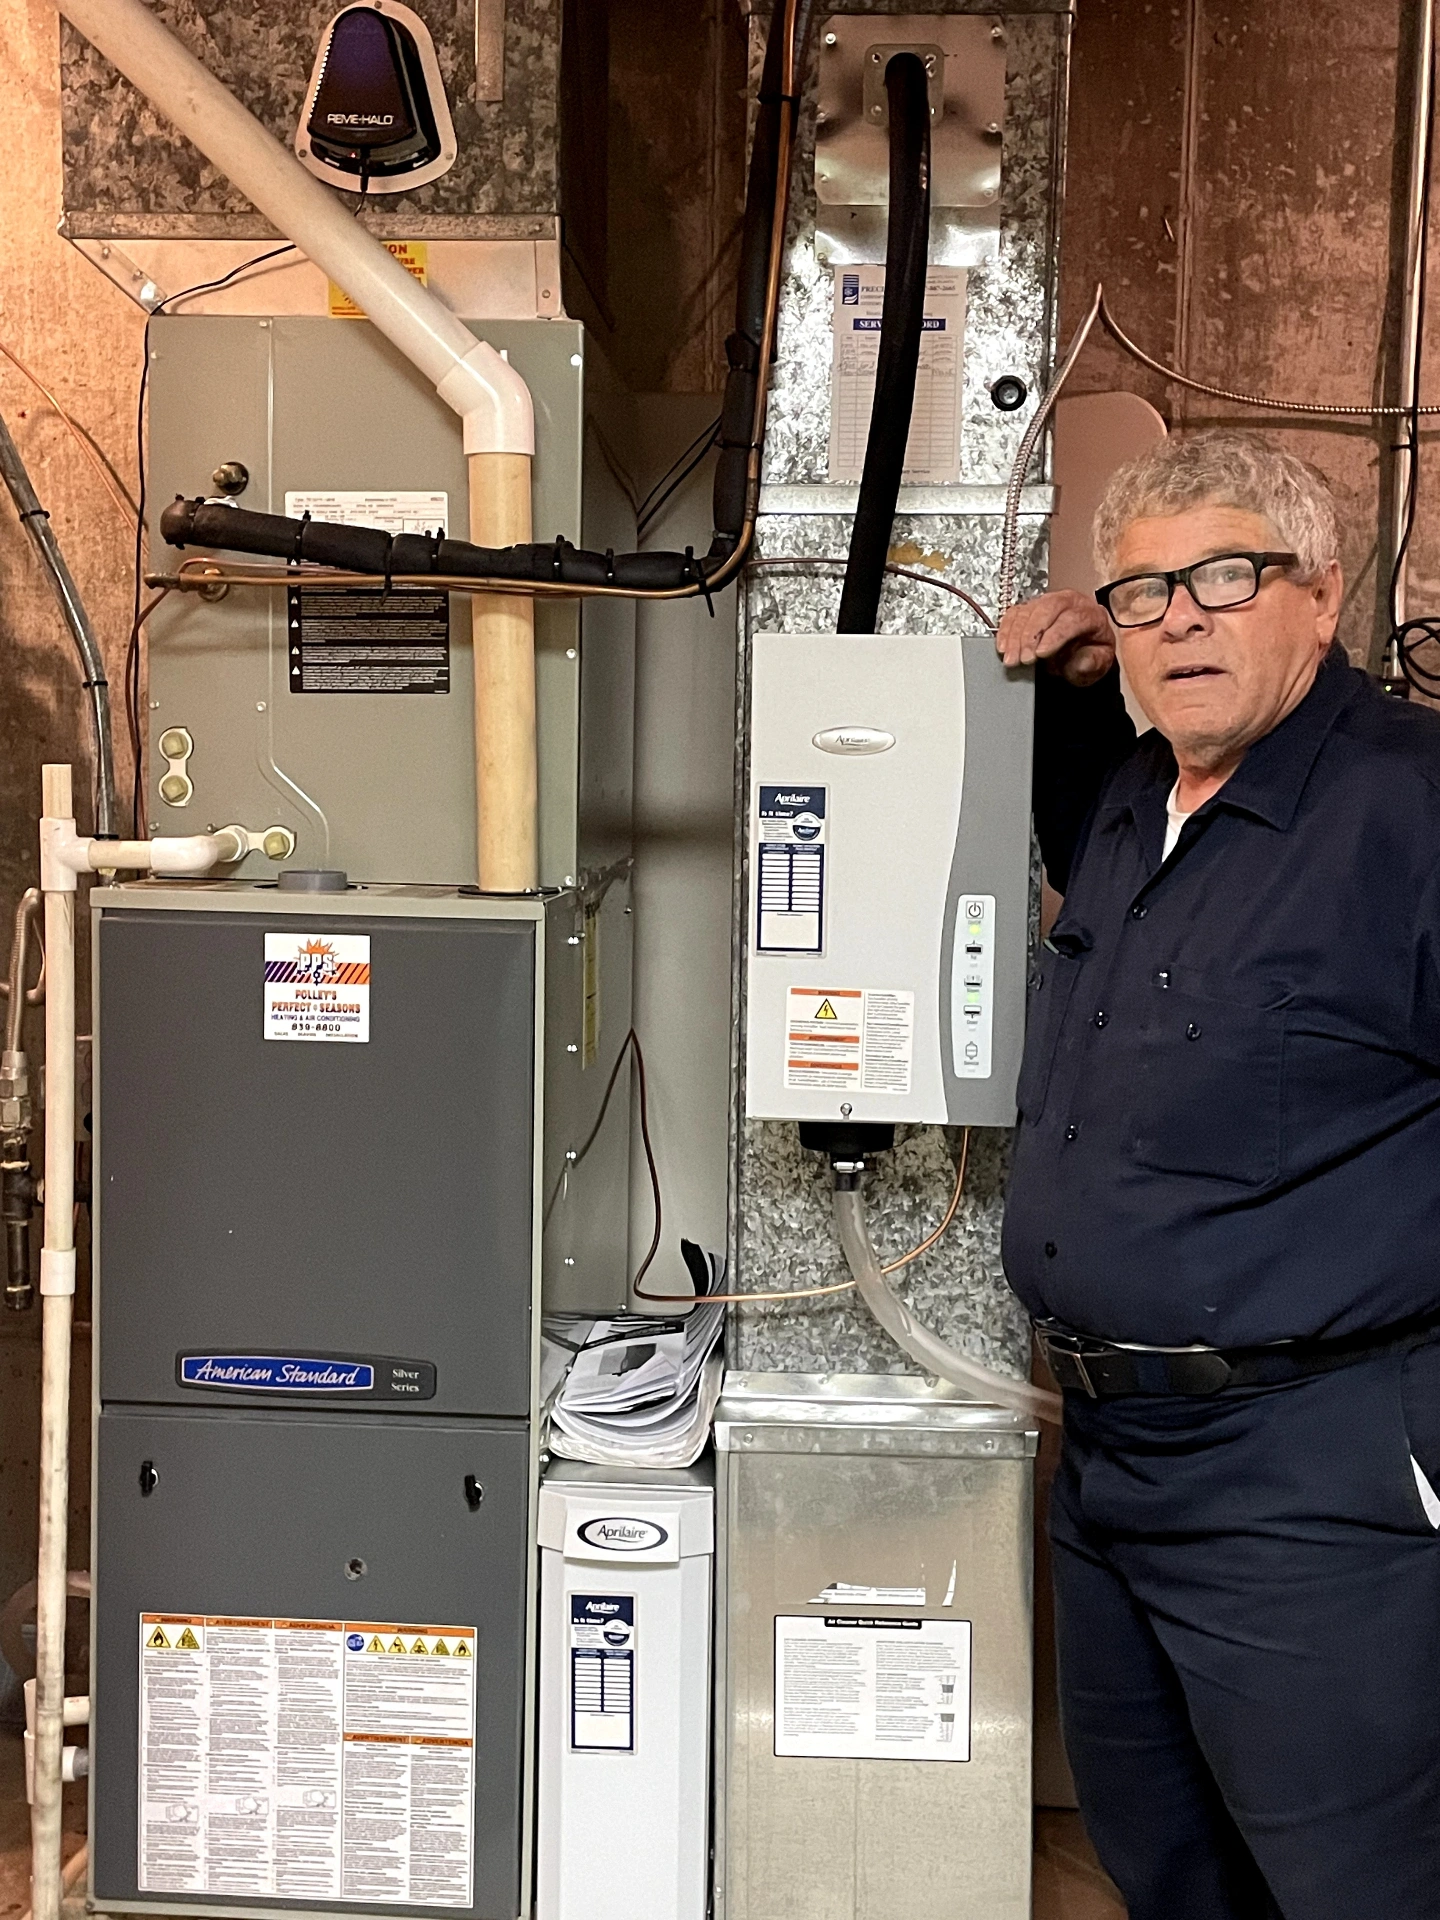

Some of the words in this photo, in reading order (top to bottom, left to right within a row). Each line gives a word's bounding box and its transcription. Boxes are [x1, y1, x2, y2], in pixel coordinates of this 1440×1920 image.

[859, 320, 882, 328] SERV
[299, 953, 335, 972] PPS
[295, 989, 338, 1000] POLLEY'S
[272, 1001, 311, 1012] PERFECT
[320, 1003, 361, 1014] SEASONS
[271, 1013, 298, 1021] HEATING
[316, 1015, 361, 1023] CONDITIONING
[194, 1359, 272, 1382] American
[276, 1363, 360, 1386] Standard
[392, 1368, 420, 1380] Silver
[391, 1381, 420, 1393] Series
[597, 1524, 648, 1541] Aprilaire
